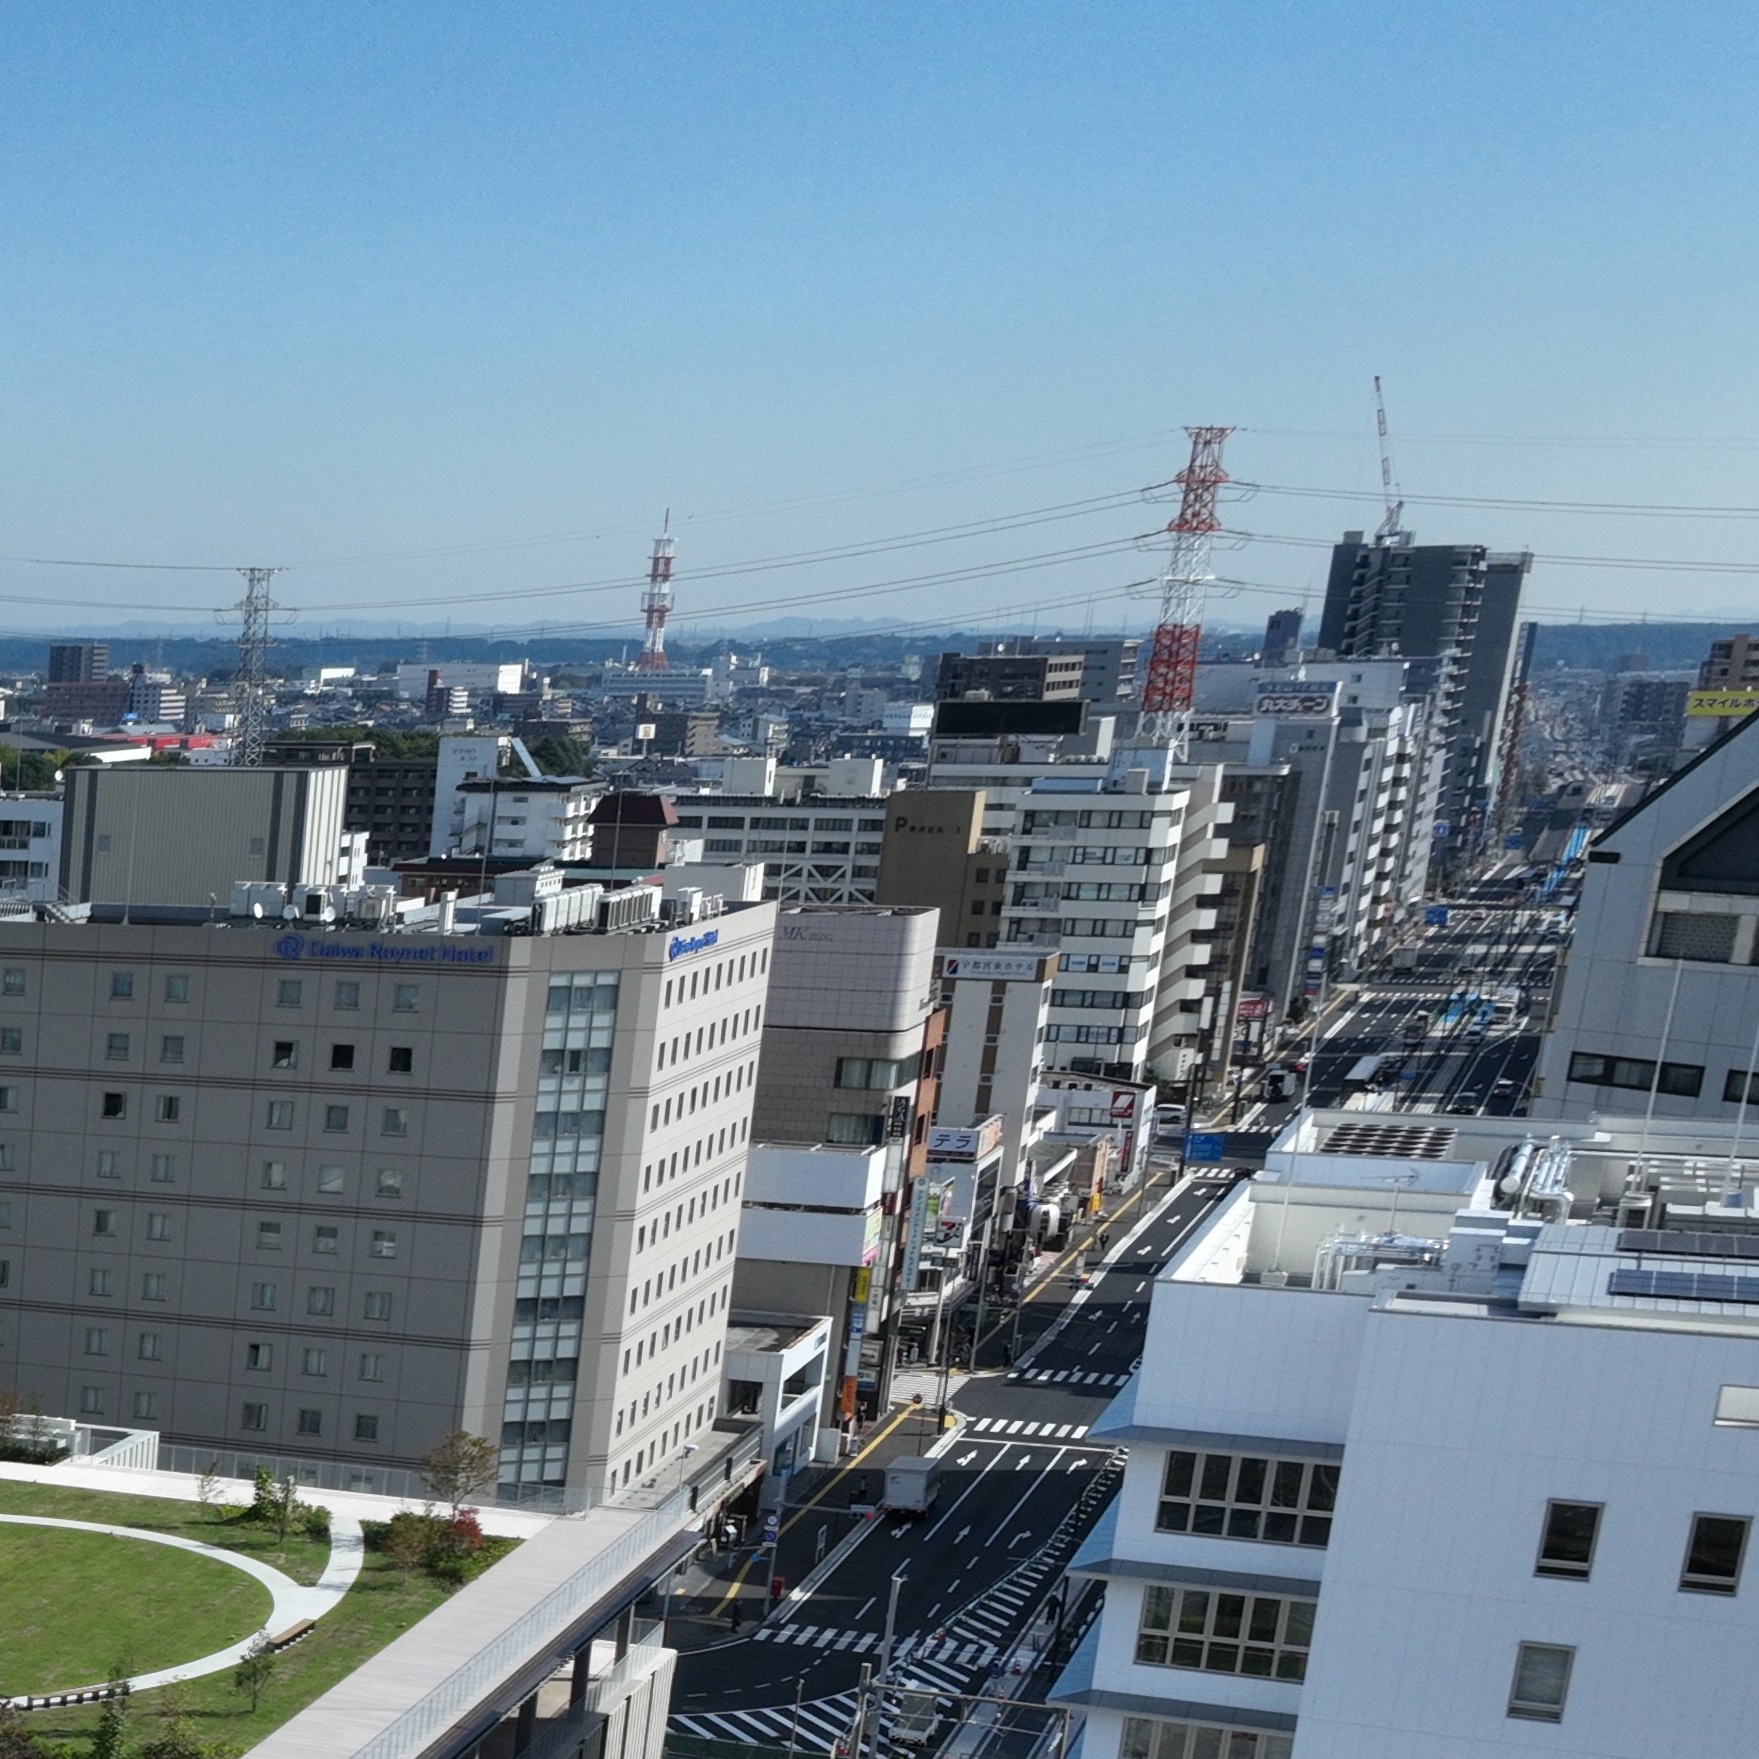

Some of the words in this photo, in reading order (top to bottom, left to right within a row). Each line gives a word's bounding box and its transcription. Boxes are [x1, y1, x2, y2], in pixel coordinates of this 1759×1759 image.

[310, 940, 362, 959] Daiwa
[368, 942, 435, 964] Roynet
[440, 945, 493, 963] Hotel
[934, 1133, 972, 1149] テラ
